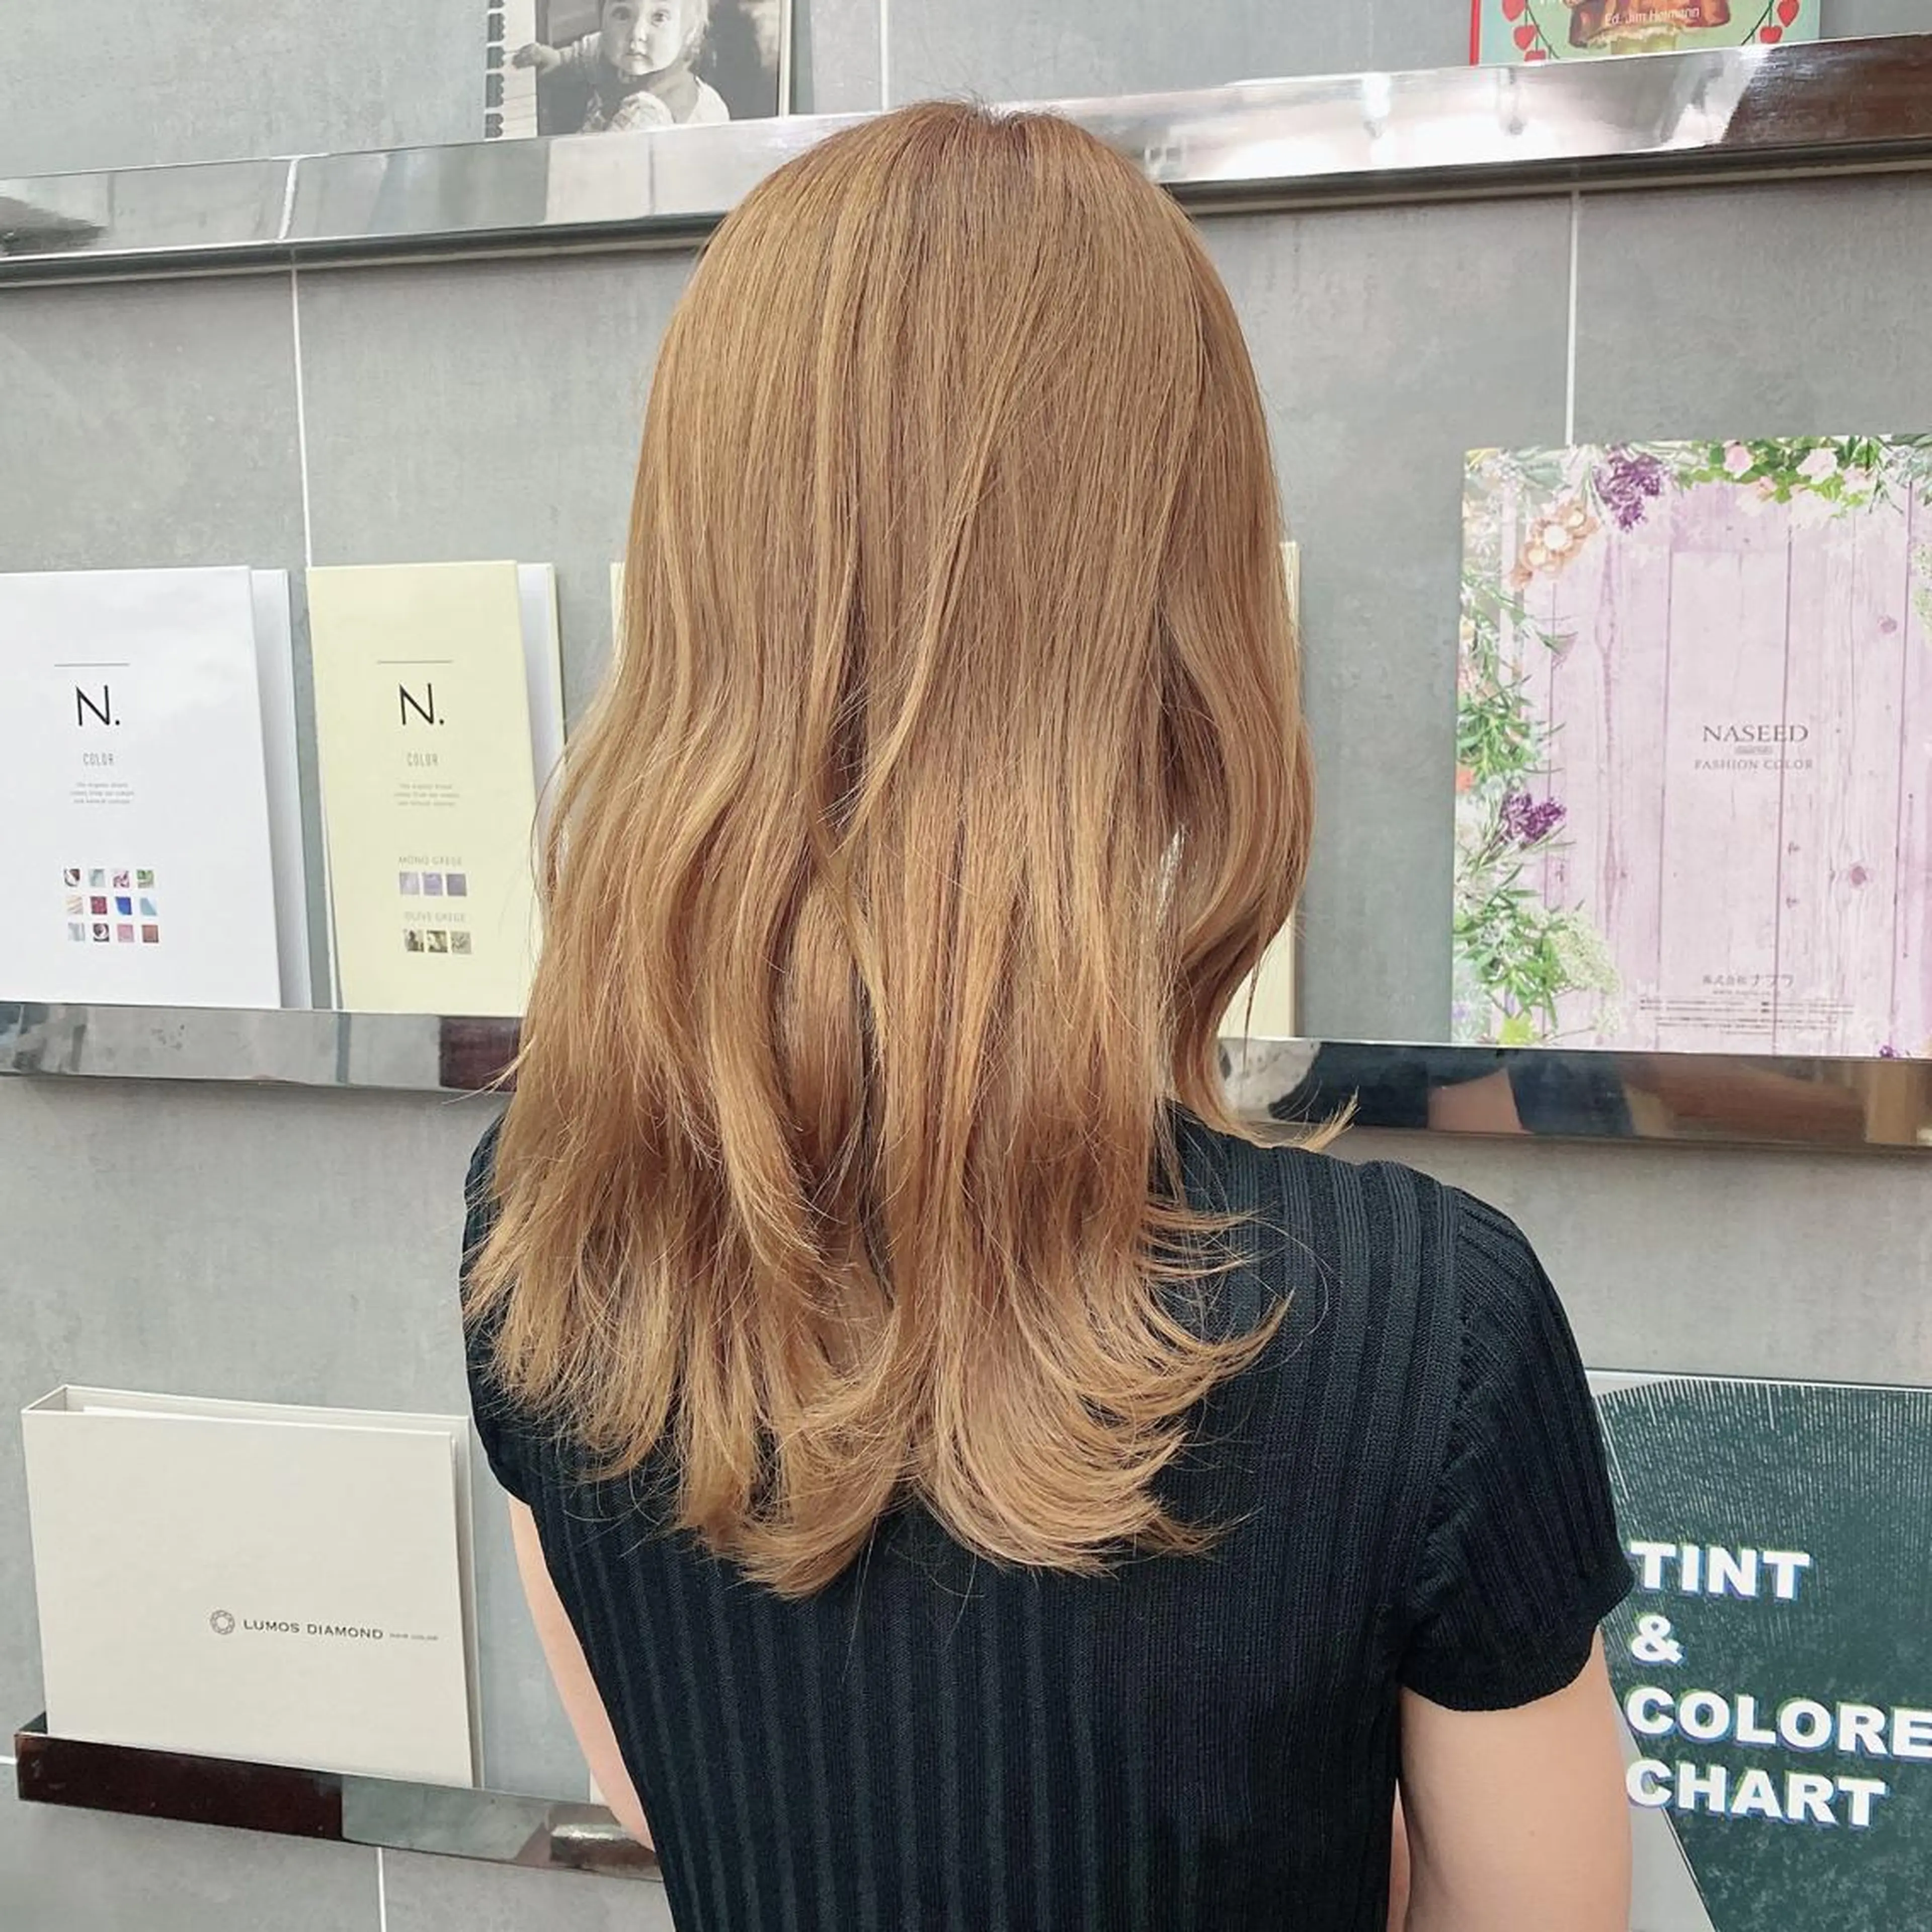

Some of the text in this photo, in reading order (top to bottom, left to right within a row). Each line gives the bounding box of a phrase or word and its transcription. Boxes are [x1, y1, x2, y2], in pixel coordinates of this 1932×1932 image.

[1626, 12, 1646, 23] Jim
[76, 684, 120, 727] N.
[398, 682, 445, 726] N.
[1702, 725, 1809, 743] NASEED
[83, 752, 115, 766] COLOR
[407, 752, 439, 767] COLOR
[1694, 759, 1813, 770] FASHION COLOR
[1630, 1541, 1811, 1599] TINT
[244, 1619, 300, 1634] LUMOS
[307, 1623, 384, 1640] DIAMOND
[1630, 1614, 1684, 1664] &
[1626, 1686, 1932, 1758] COLORE
[1626, 1759, 1887, 1827] CHART
